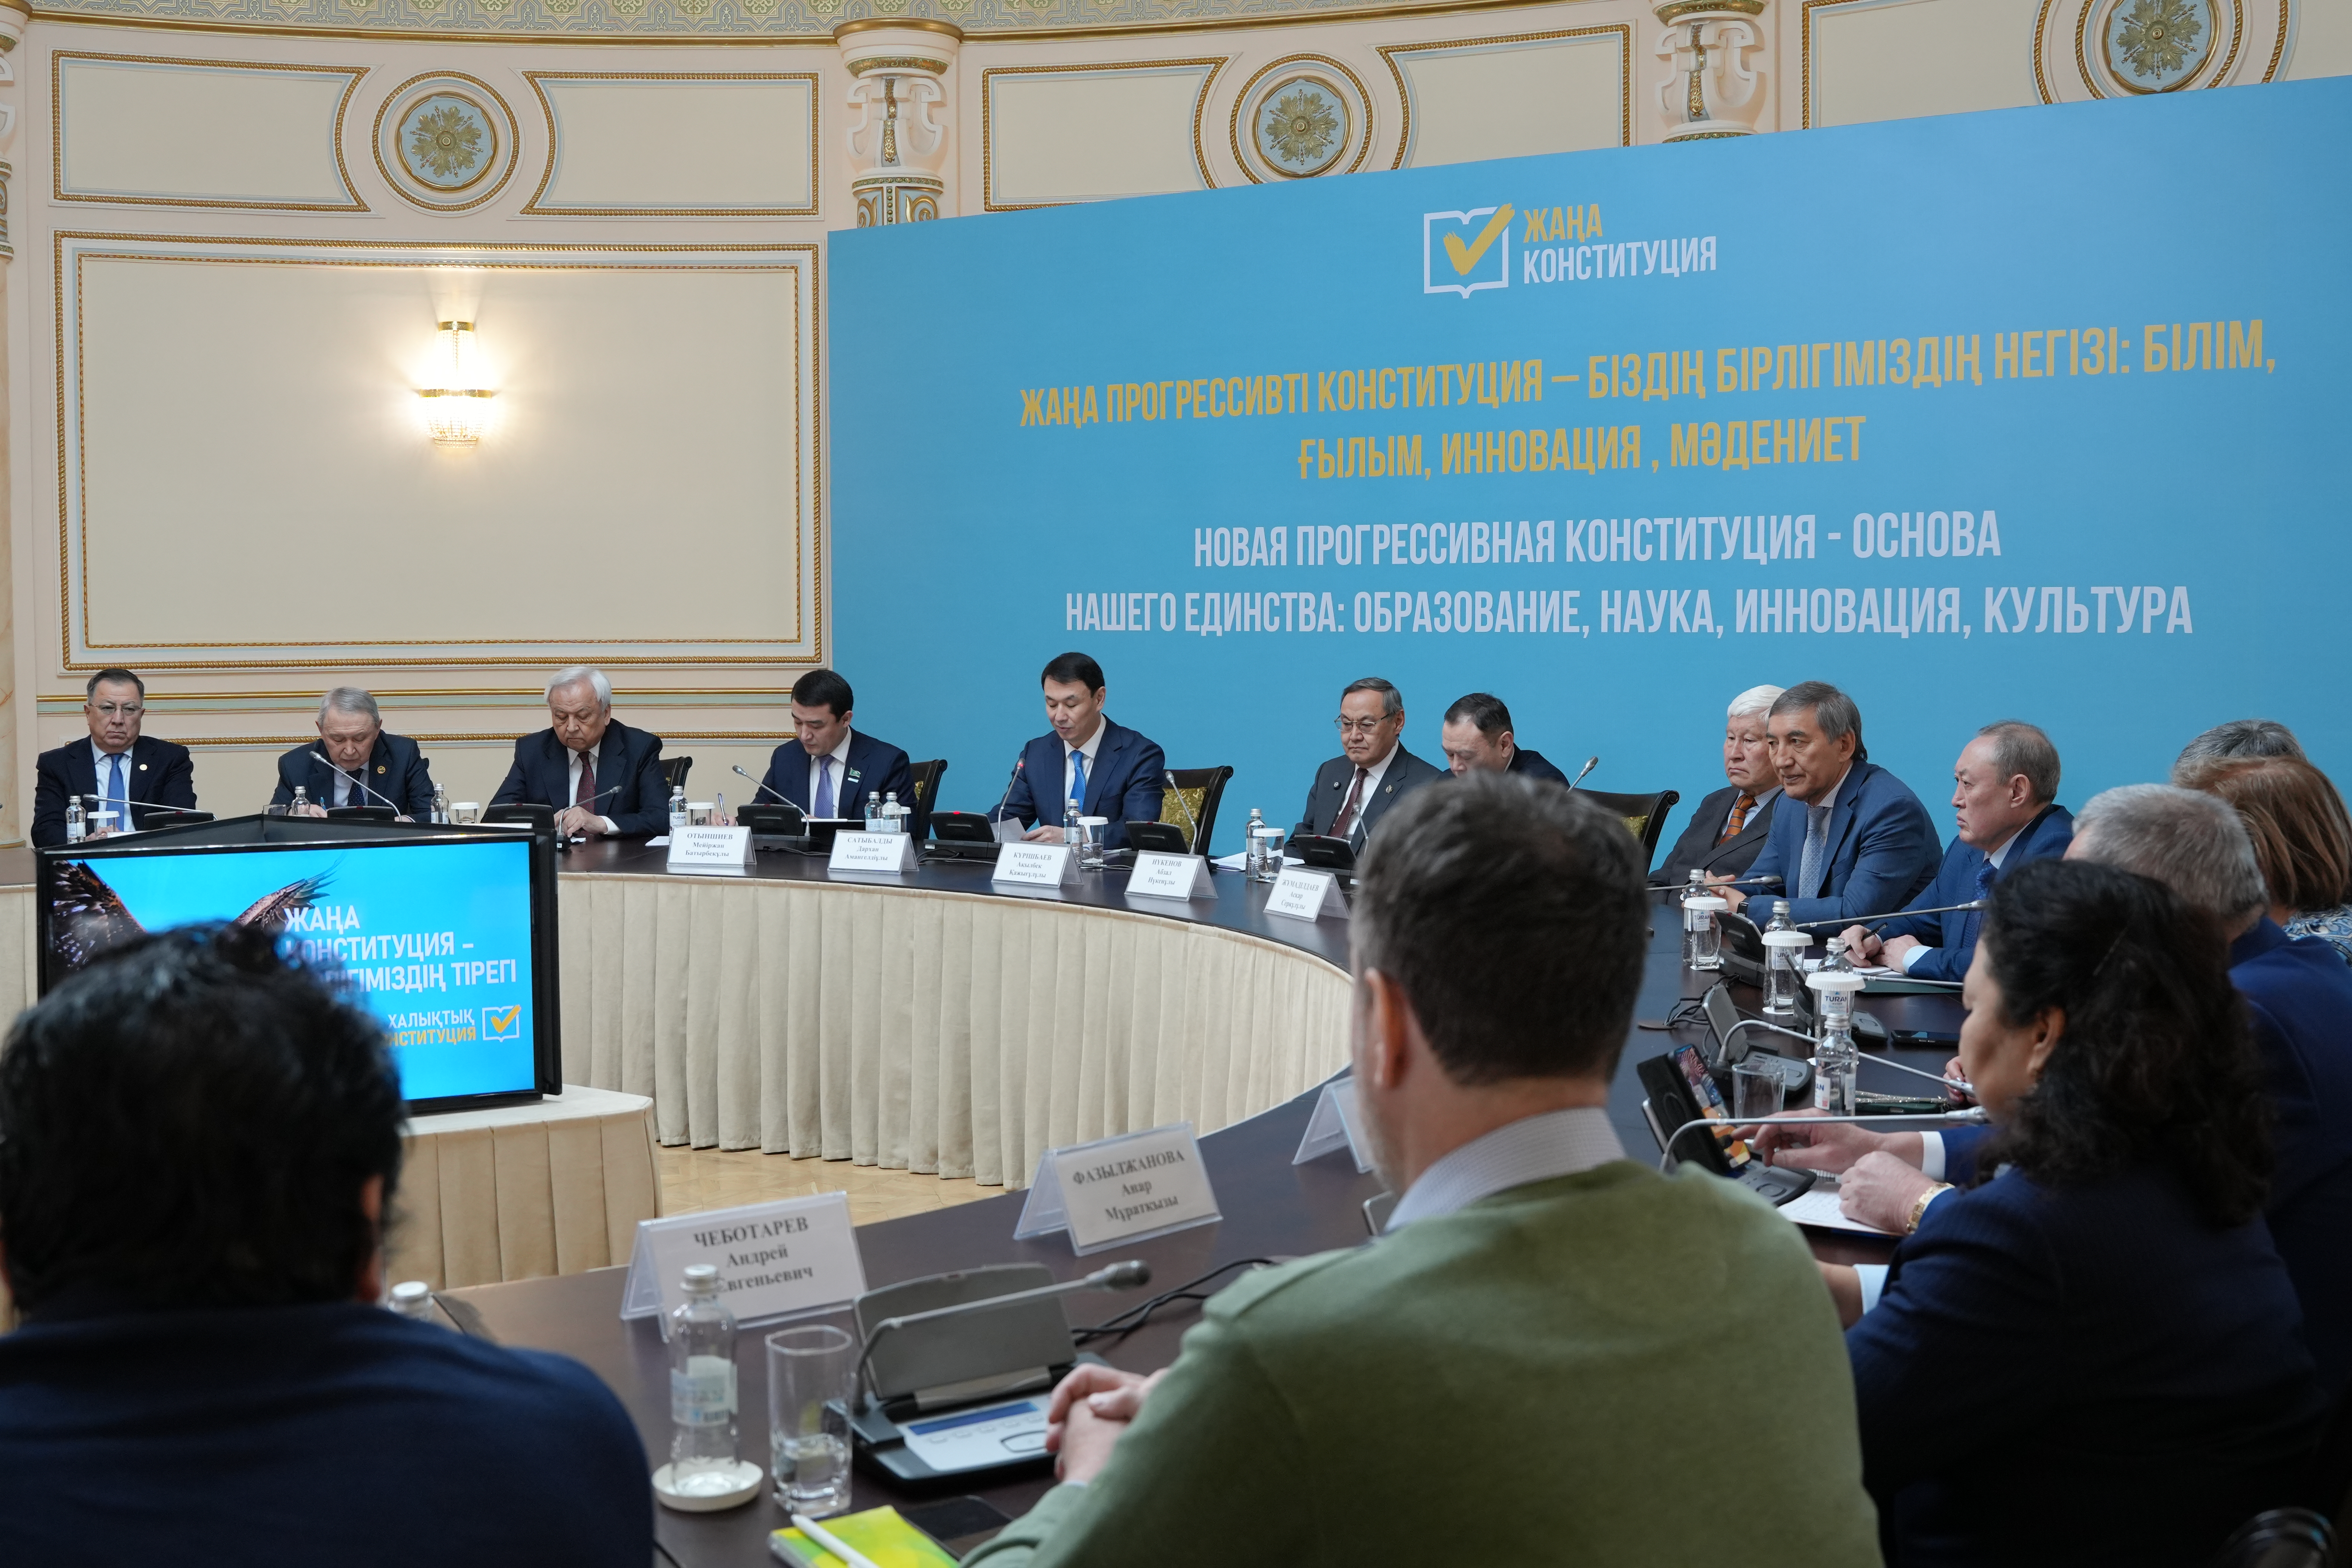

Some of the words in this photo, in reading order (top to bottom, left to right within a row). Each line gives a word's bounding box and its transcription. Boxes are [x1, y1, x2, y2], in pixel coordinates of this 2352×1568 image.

[1523, 203, 1603, 243] ЖАҢА
[1524, 236, 1717, 283] КОНСТИТУЦИЯ
[1020, 381, 1099, 429] ЖАҢА
[1106, 373, 1308, 422] ПРОГРЕССИВТІ
[1318, 359, 1542, 412] КОНСТИТУЦИЯ
[1589, 349, 1706, 398] БІЗДІҢ
[1717, 334, 1982, 392] БІРЛІГІМІЗДІҢ
[1995, 327, 2130, 379] НЕГІЗІ:
[2144, 319, 2276, 374] БІЛІМ,
[1298, 437, 1431, 481] ҒЫЛЫМ,
[1442, 425, 1641, 475] ИННОВАЦИЯ
[1671, 416, 1866, 471] МӘДЕНИЕТ
[1195, 526, 1287, 567] НОВАЯ
[1297, 520, 1555, 566] ПРОГРЕССИВНАЯ
[1566, 515, 1815, 565] КОНСТИТУЦИЯ
[1853, 510, 2001, 558] ОСНОВА
[1066, 593, 1176, 631] НАШЕГО
[1185, 591, 1344, 636] ЕДИНСТВА:
[1354, 590, 1589, 639] ОБРАЗОВАНИЕ,
[1601, 590, 1723, 639] НАУКА,
[1736, 587, 1971, 639] ИННОВАЦИЯ,
[1985, 586, 2193, 634] КУЛЬТУРА
[284, 905, 360, 935] ЖАҢА
[450, 959, 517, 986] ТІРЕГІ
[387, 1008, 475, 1029] ХАЛЫҚТЫҚ
[1072, 1149, 1185, 1184] ФАЗЫЛЖАНОВА
[1122, 1180, 1152, 1196] Анар
[694, 1216, 809, 1247] ЧЕБОТАРЕВ
[727, 1243, 788, 1268] Андрей
